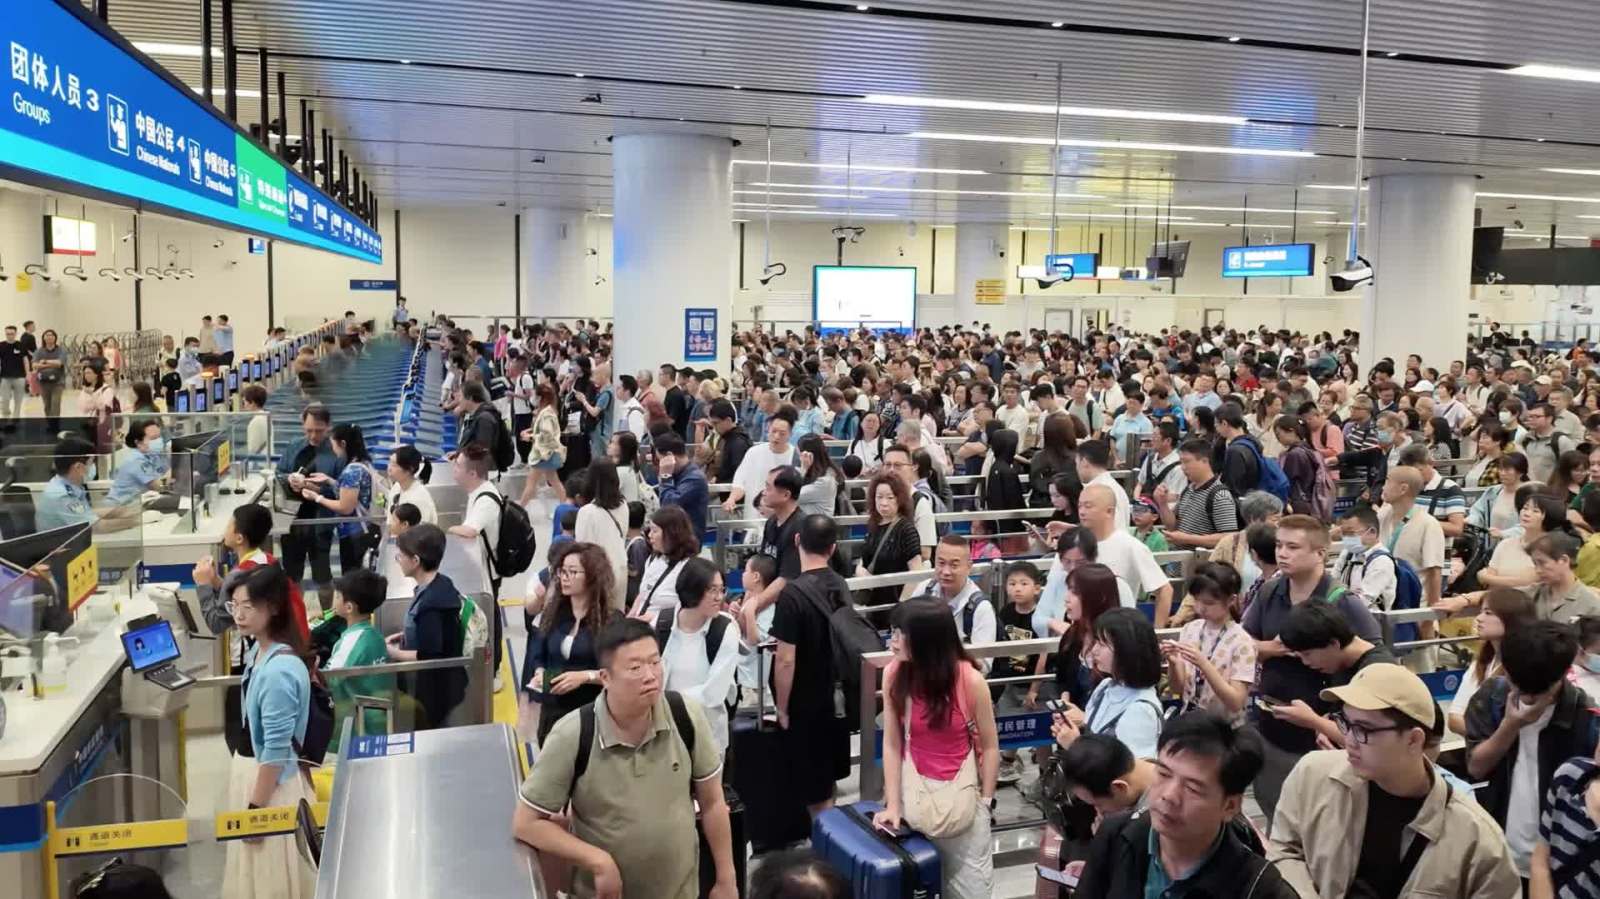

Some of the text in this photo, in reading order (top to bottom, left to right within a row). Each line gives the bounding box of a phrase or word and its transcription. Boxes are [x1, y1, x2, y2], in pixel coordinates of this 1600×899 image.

[11, 41, 99, 112] 团体人员 3
[13, 91, 51, 126] Groups
[135, 110, 185, 153] 中国公民 4
[230, 163, 236, 178] 5
